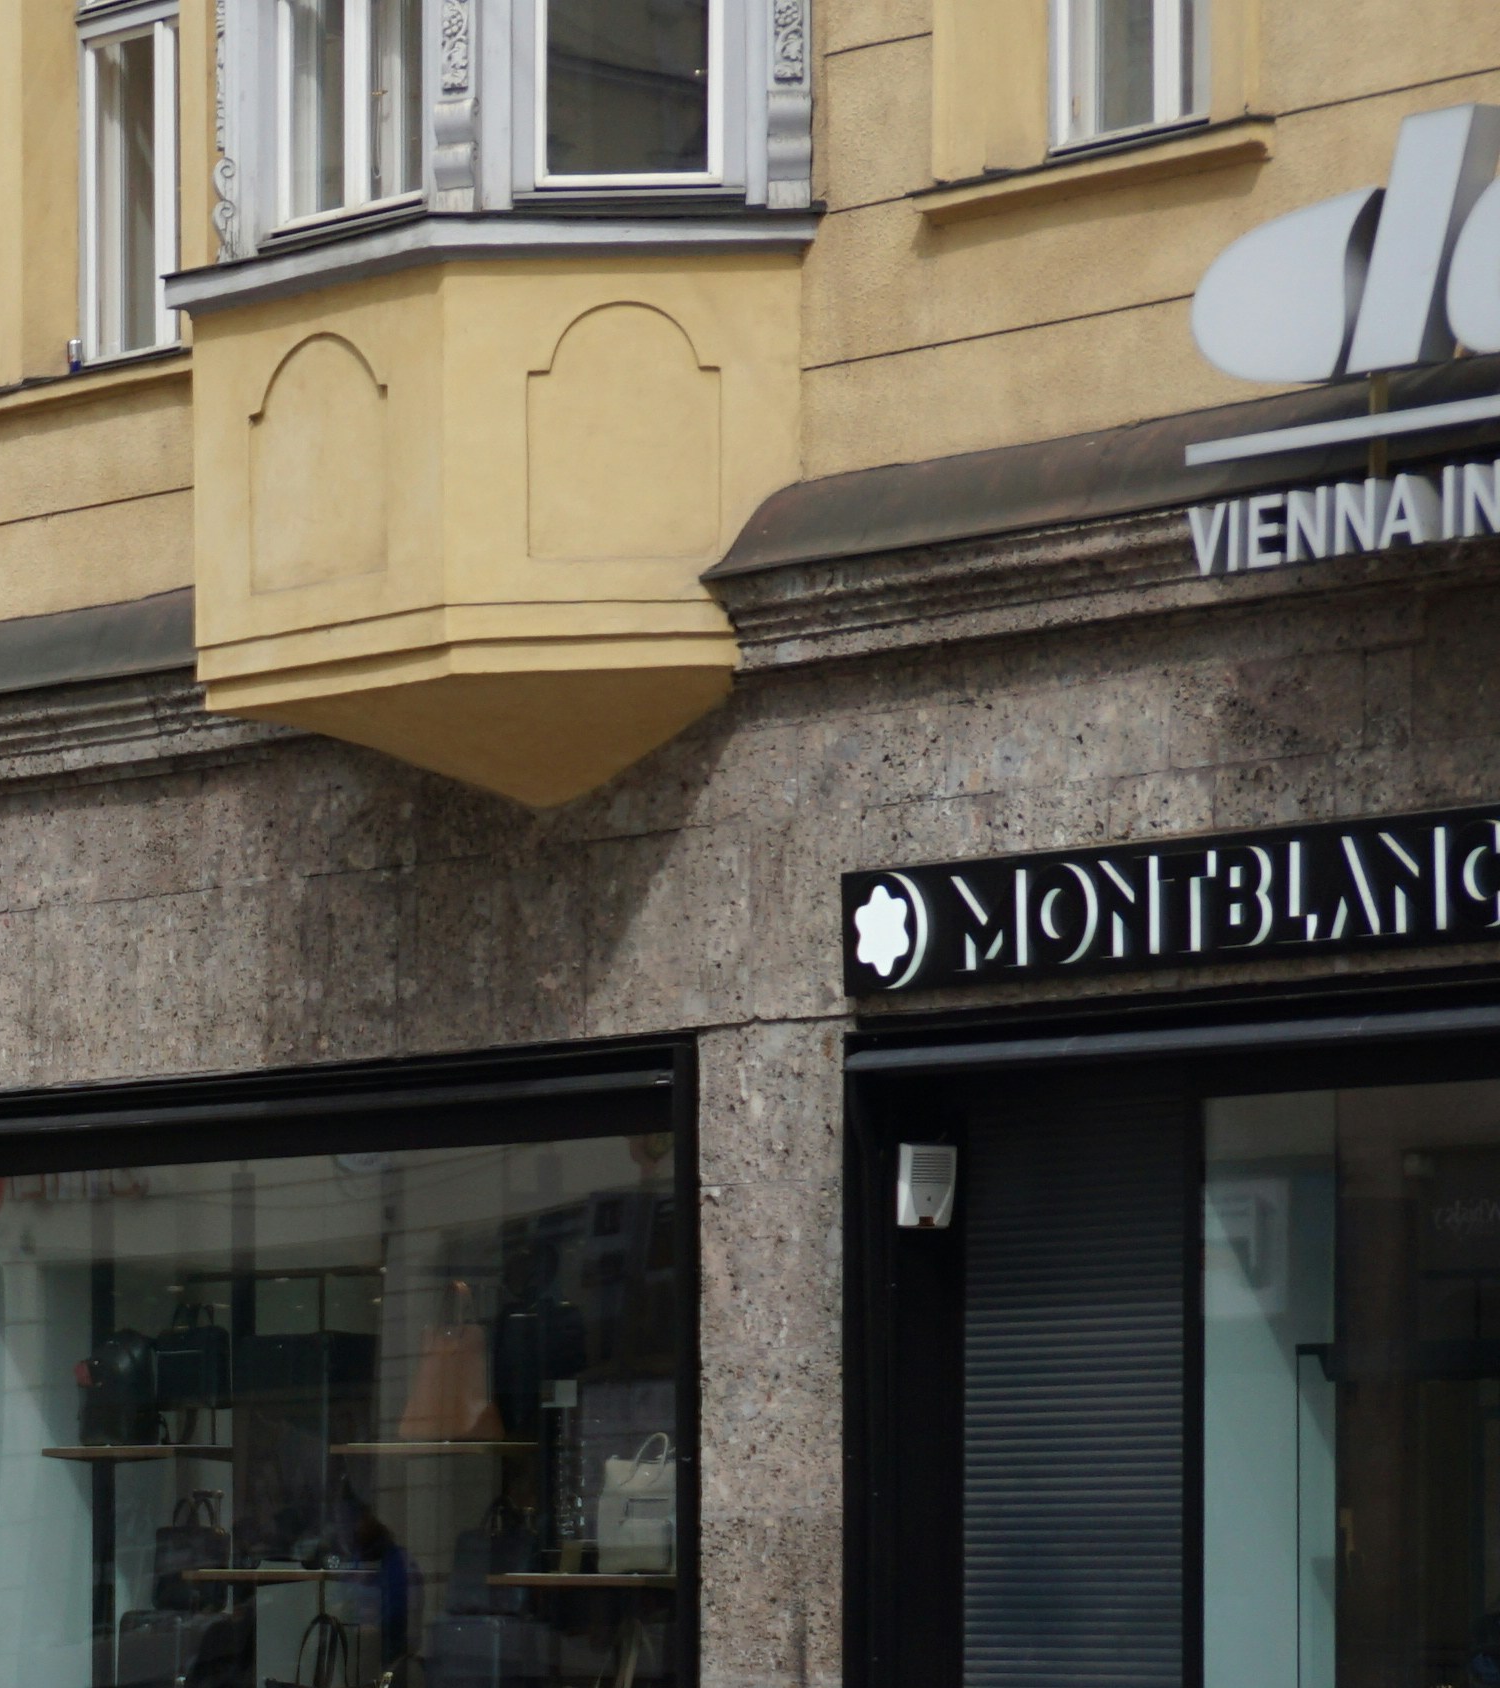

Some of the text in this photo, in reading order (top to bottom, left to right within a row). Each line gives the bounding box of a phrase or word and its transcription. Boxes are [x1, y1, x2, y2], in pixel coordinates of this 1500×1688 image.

[1188, 457, 1500, 576] VIENNA IN
[949, 818, 1500, 974] MONTBLANC
